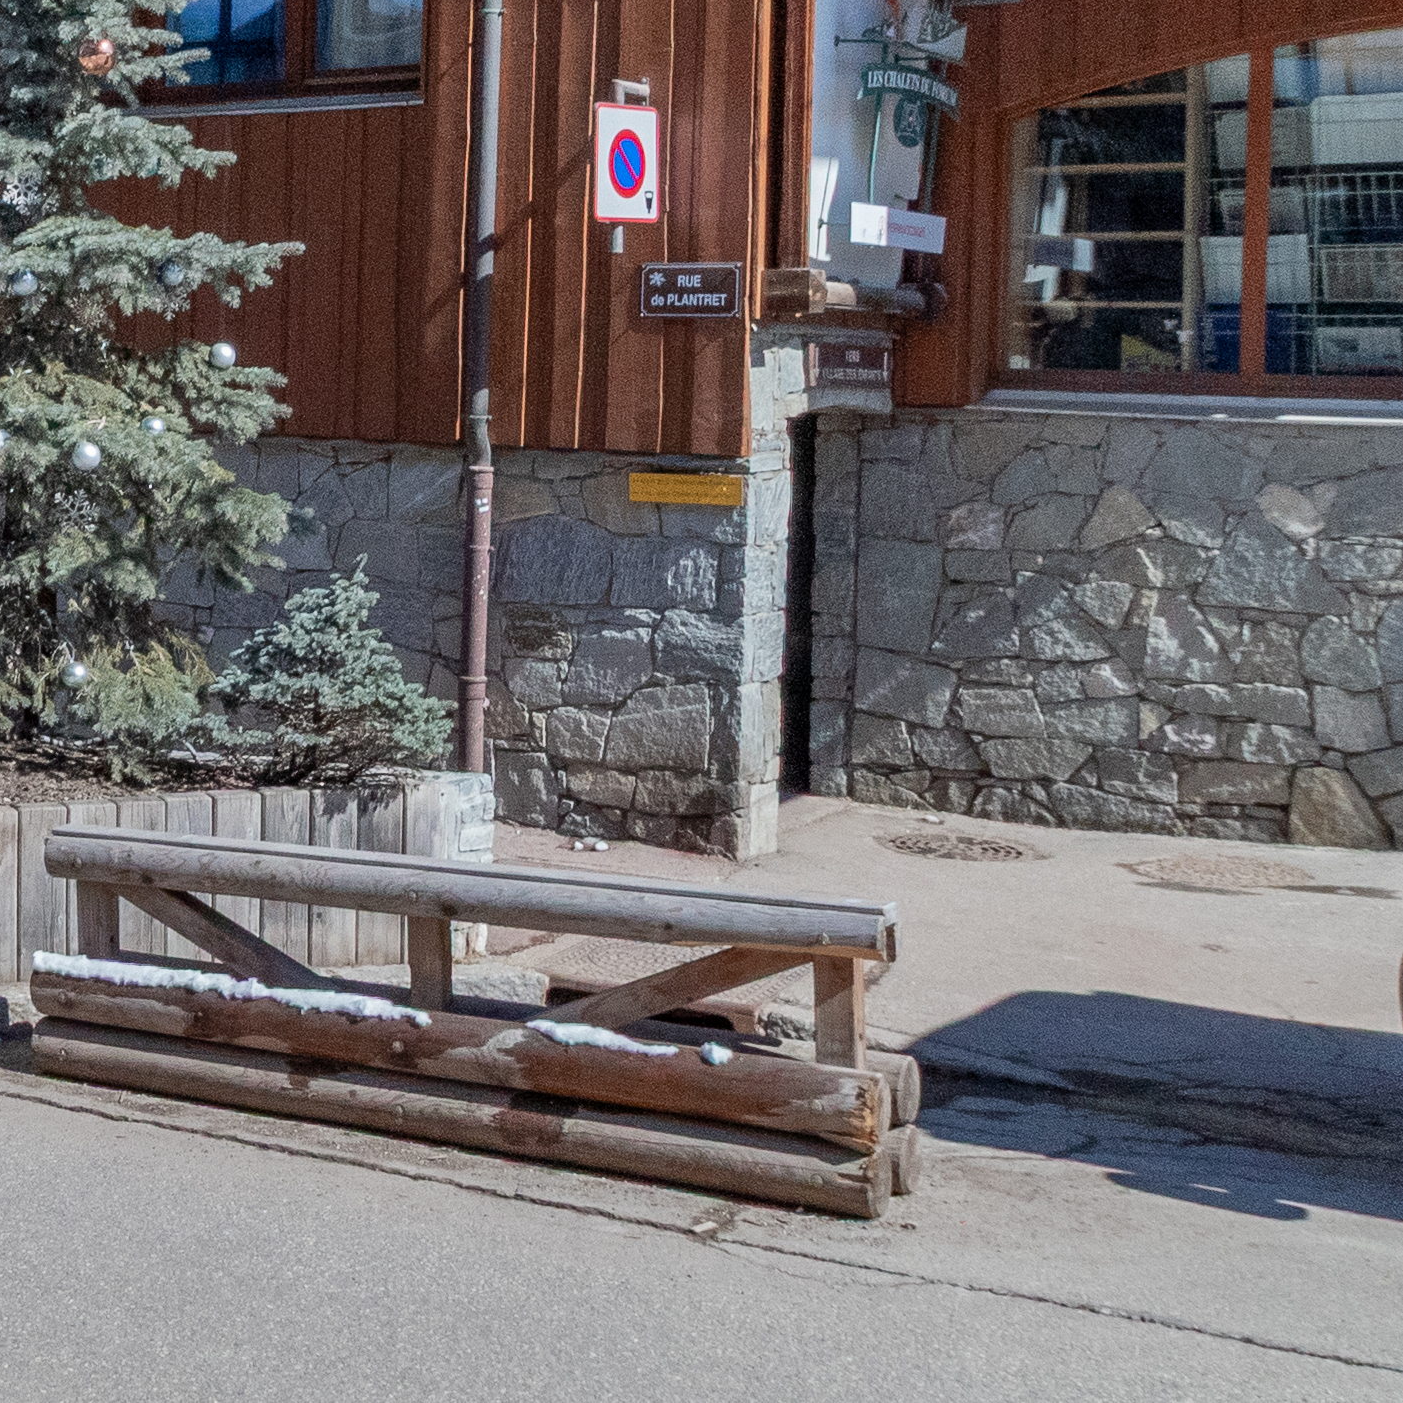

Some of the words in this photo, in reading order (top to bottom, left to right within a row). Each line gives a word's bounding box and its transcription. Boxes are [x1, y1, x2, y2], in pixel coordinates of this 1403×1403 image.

[868, 70, 884, 88] LES
[884, 70, 921, 92] CHALETS
[677, 275, 702, 287] RUE
[650, 294, 665, 306] de
[666, 293, 728, 306] PLANTRET
